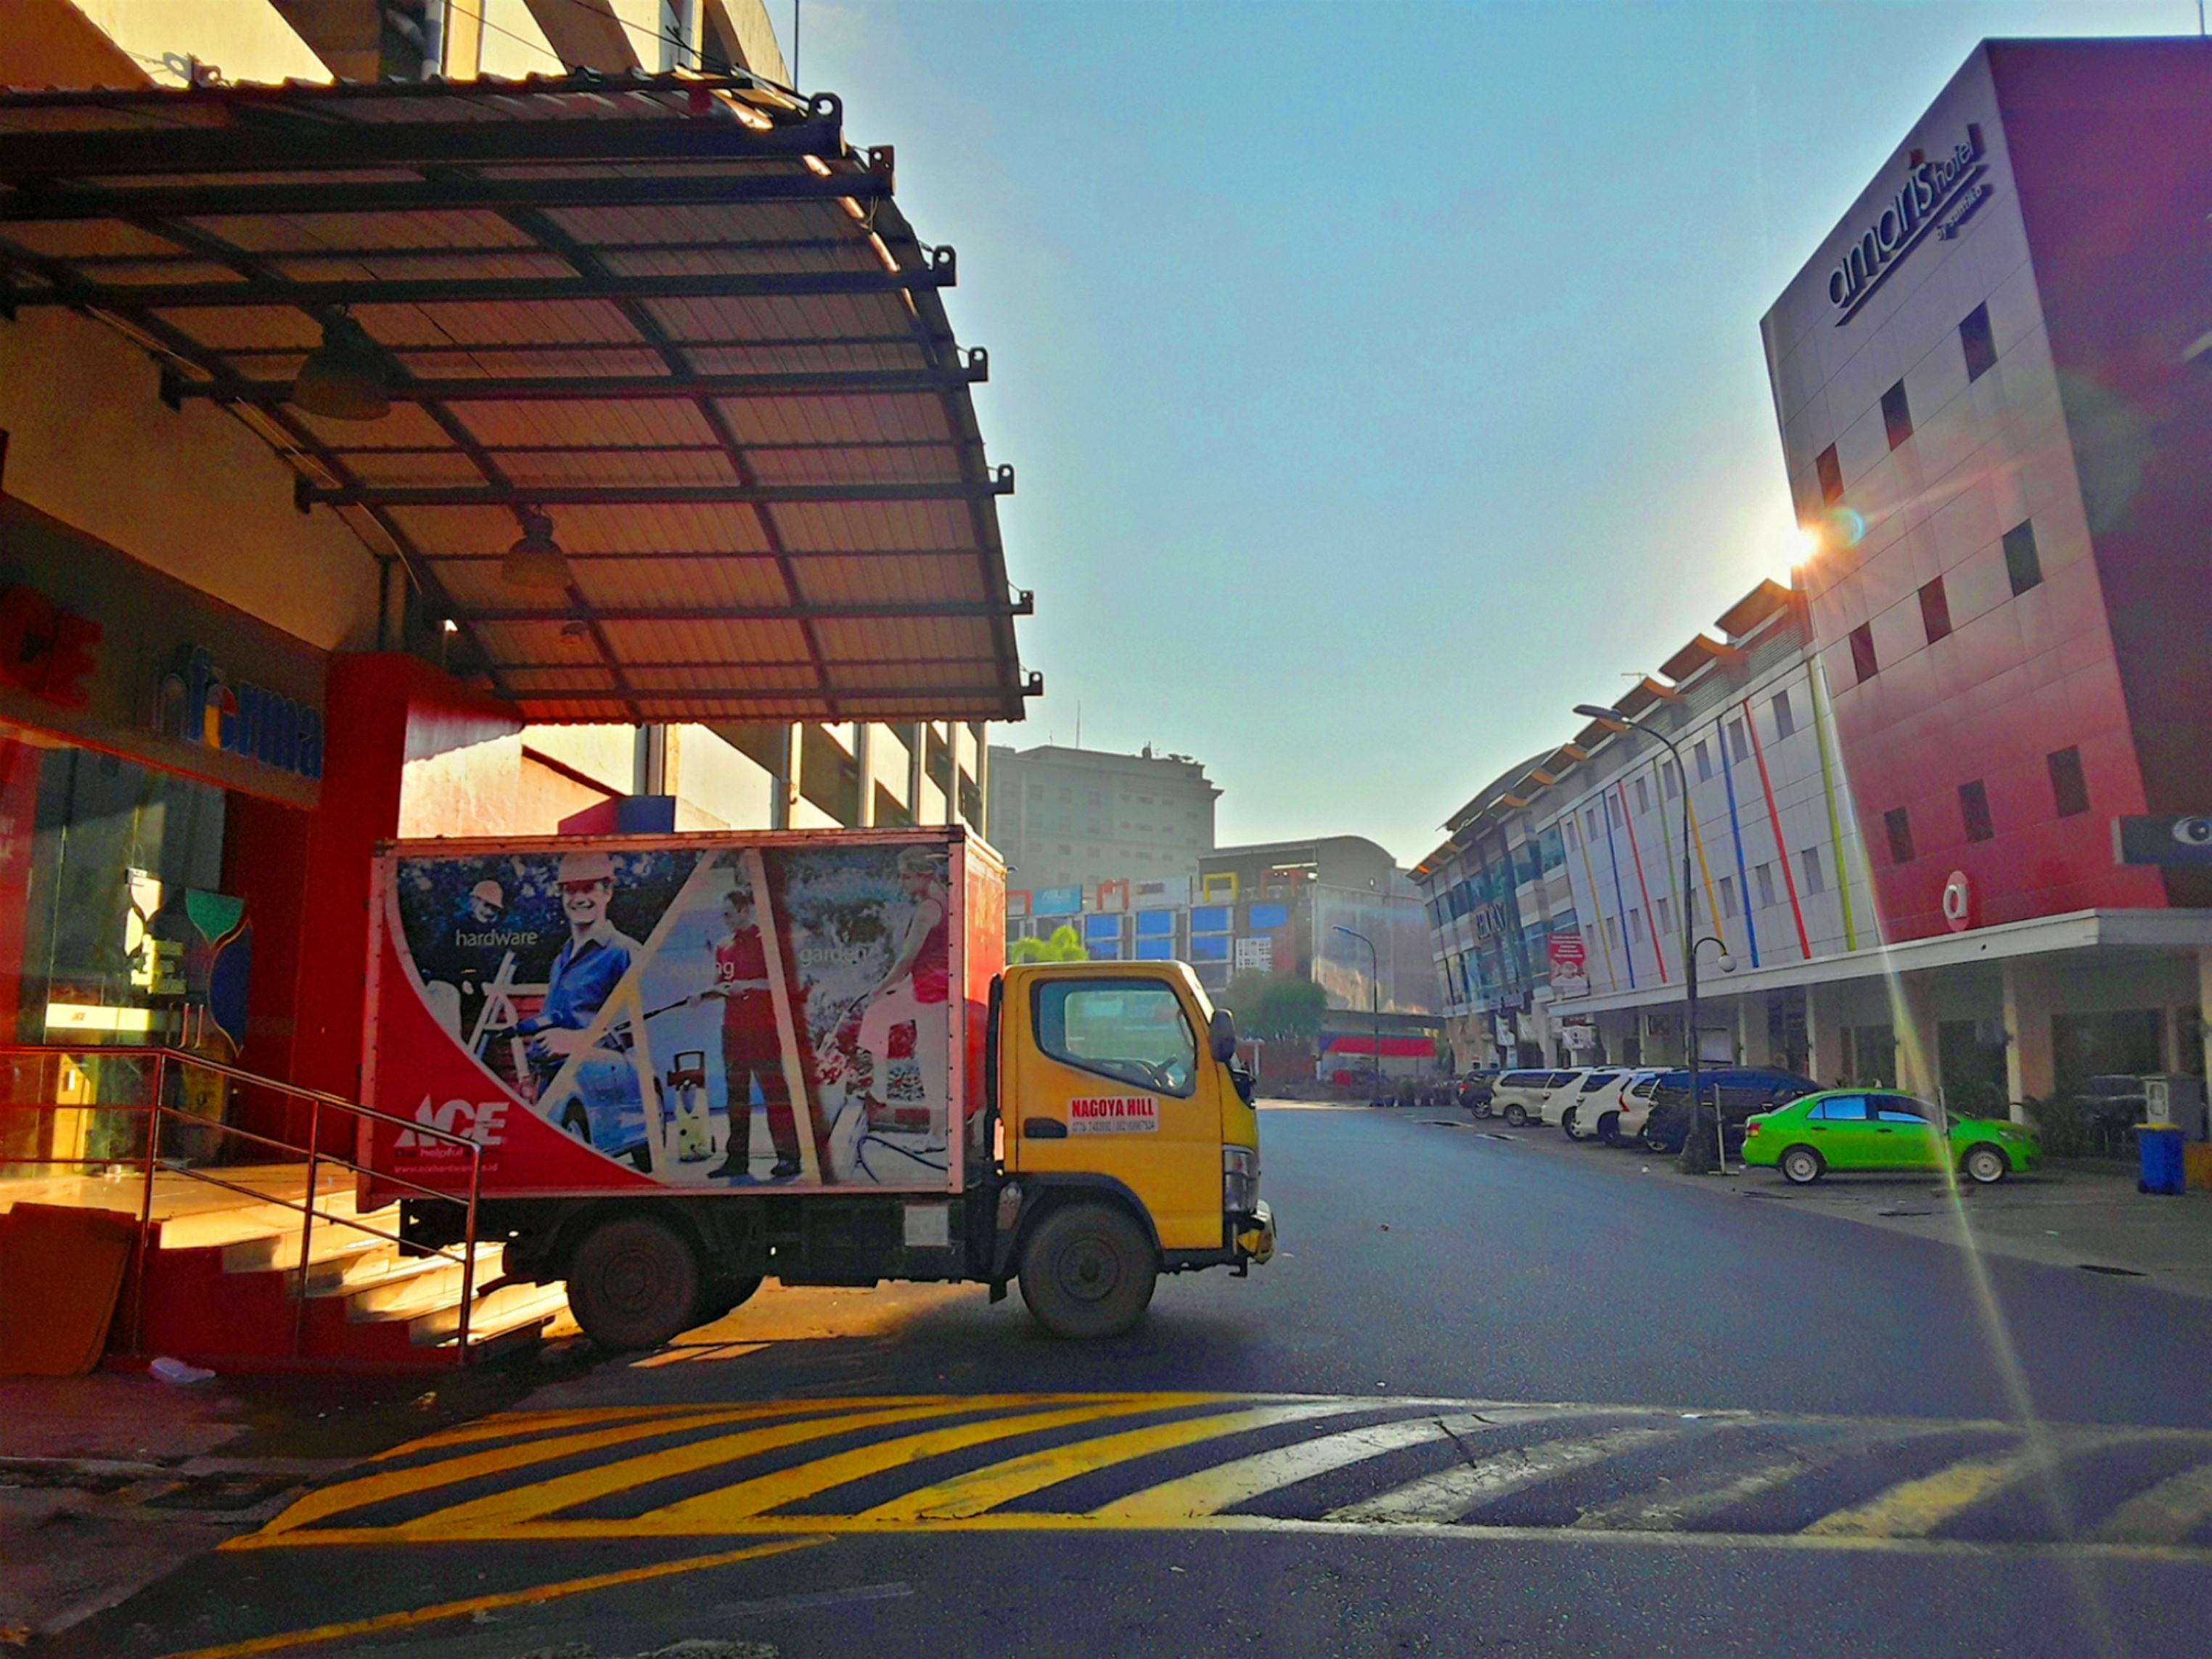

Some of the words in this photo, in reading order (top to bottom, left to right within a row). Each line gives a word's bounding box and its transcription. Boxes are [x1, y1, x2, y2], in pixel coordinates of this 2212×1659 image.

[1828, 149, 1933, 308] amaris
[1933, 140, 1974, 194] hotel
[456, 929, 538, 946] hardware
[800, 943, 867, 967] garden
[1072, 1099, 1124, 1118] NAGOYA
[1127, 1098, 1154, 1116] HILL
[393, 1092, 510, 1147] ACE
[420, 1148, 463, 1158] helpful
